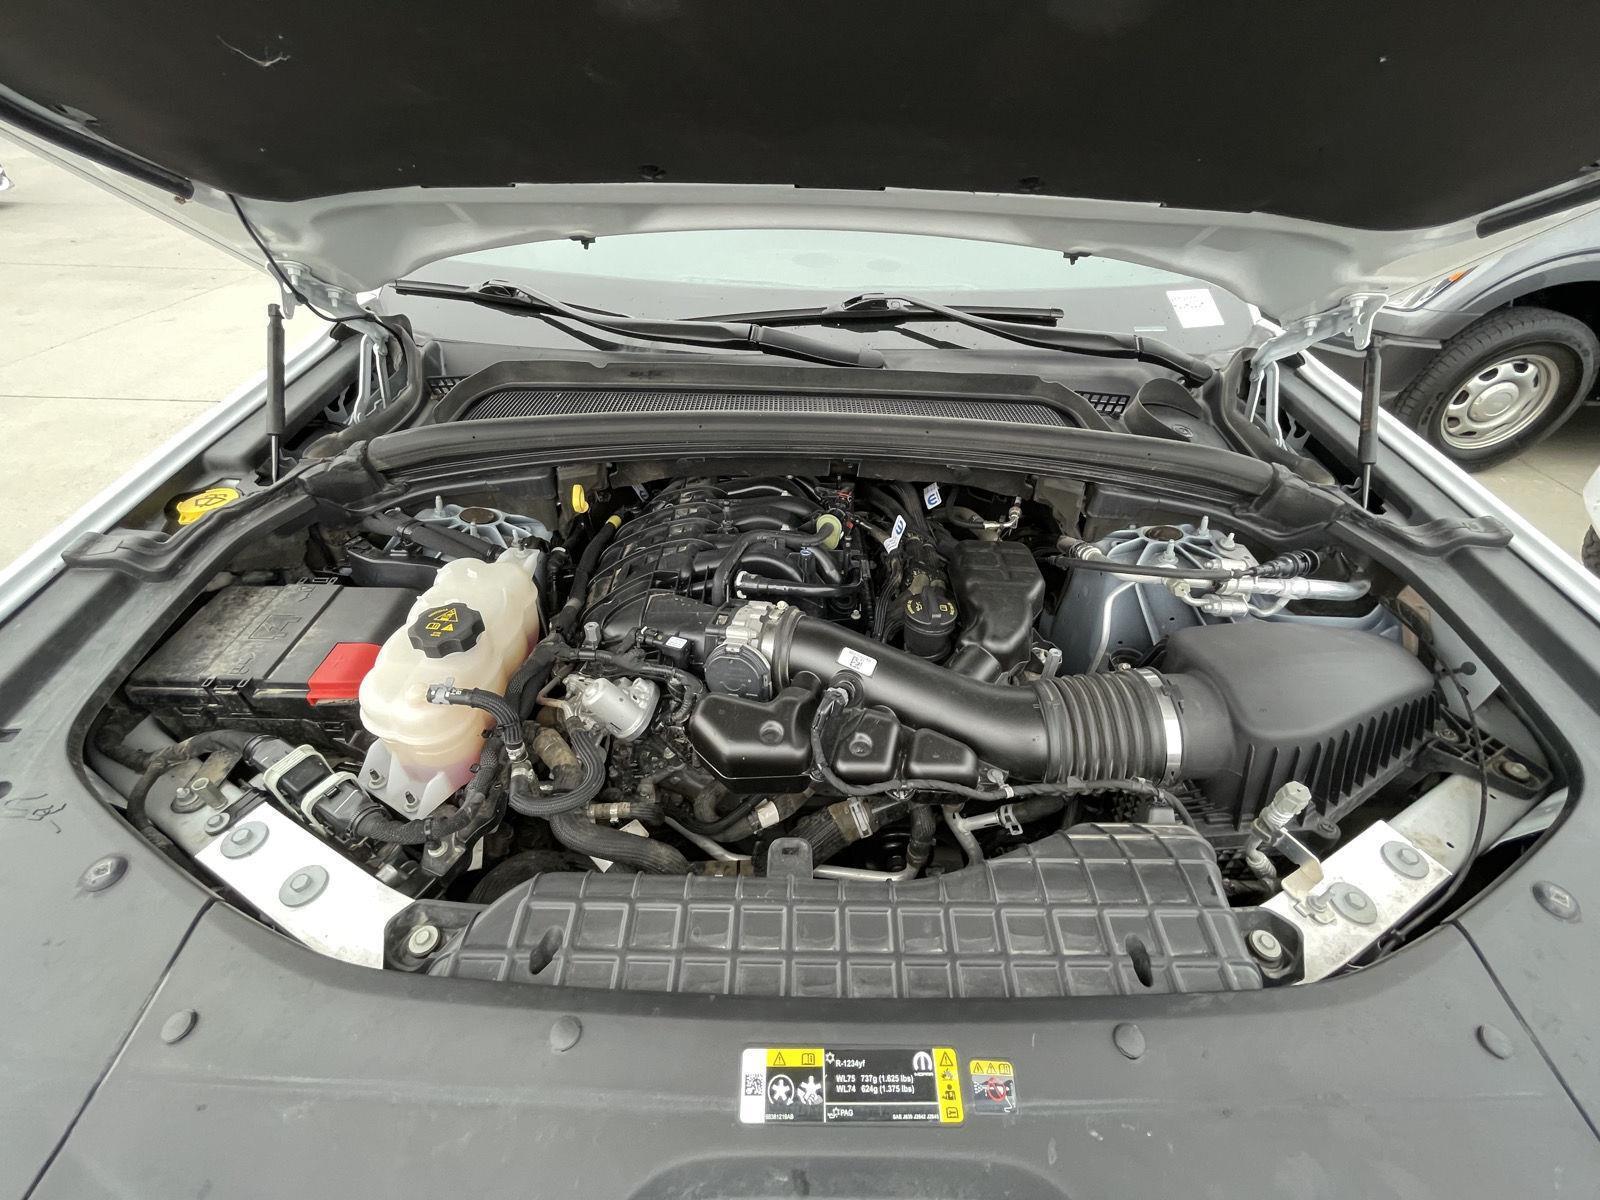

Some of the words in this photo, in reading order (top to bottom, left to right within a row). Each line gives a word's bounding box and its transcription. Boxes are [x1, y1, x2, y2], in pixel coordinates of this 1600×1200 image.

[835, 1059, 865, 1069] R-1234yf
[836, 1074, 856, 1083] WL75
[861, 1074, 877, 1084] 737g
[879, 1074, 899, 1084] (1.625
[900, 1074, 914, 1084] lbs)
[836, 1084, 856, 1093] WL74
[861, 1084, 878, 1094] 624g
[880, 1084, 900, 1094] (1.375
[902, 1084, 915, 1094] lbs)
[840, 1108, 854, 1117] PAG
